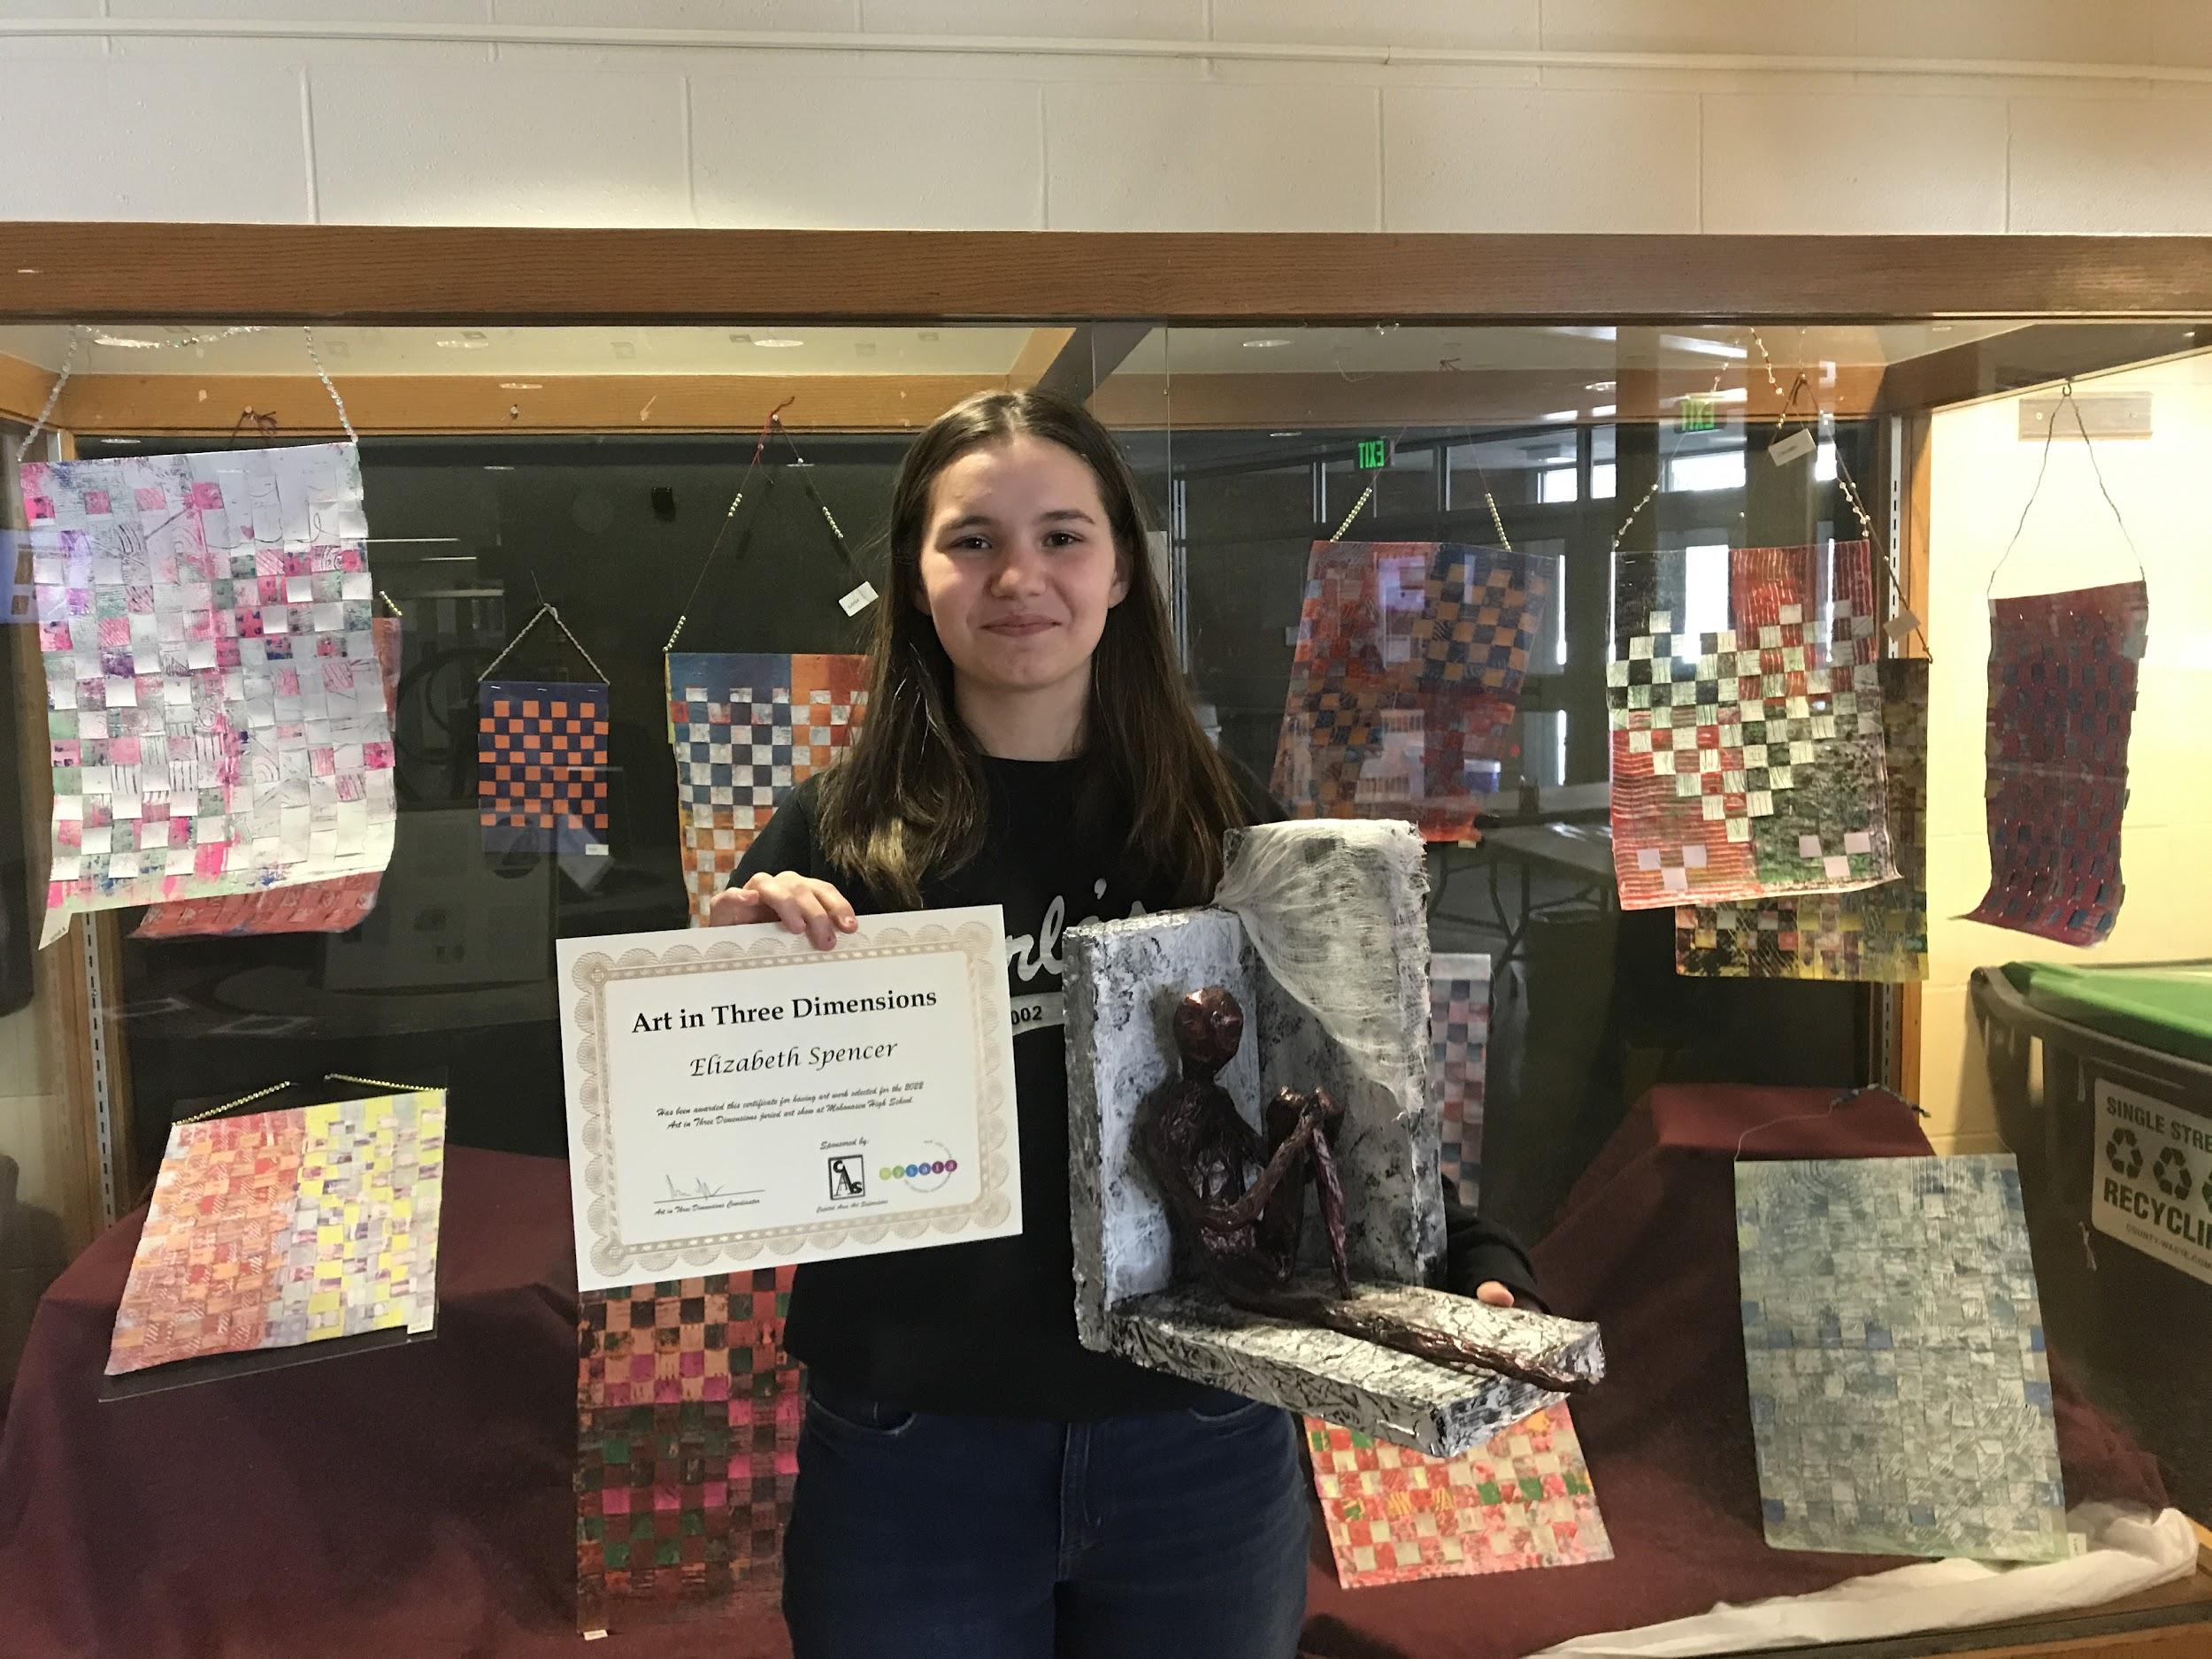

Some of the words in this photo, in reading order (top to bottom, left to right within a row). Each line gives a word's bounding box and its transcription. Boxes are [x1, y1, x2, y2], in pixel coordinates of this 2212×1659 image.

[632, 1011, 672, 1033] Art
[680, 1009, 705, 1029] in
[711, 1003, 784, 1025] Three
[791, 989, 937, 1018] Dimensions
[689, 1046, 802, 1077] Elizabeth
[809, 1042, 898, 1071] Spencer
[657, 1108, 673, 1118] Has
[675, 1106, 691, 1116] been
[693, 1103, 725, 1113] awarded
[726, 1101, 741, 1110] this
[742, 1099, 778, 1110] certificate
[780, 1096, 790, 1107] for
[792, 1094, 816, 1103] having
[832, 1089, 849, 1099] work
[850, 1087, 877, 1097] selected
[879, 1086, 889, 1096] for
[891, 1083, 902, 1093] the
[904, 1081, 925, 1091] 2022
[666, 1120, 682, 1130] Art
[693, 1117, 714, 1127] Three
[715, 1114, 757, 1125] Dimensions
[759, 1110, 781, 1122] juried
[797, 1106, 814, 1117] show
[866, 1098, 886, 1109] High
[2107, 1096, 2166, 1134] SINGLE
[819, 1140, 857, 1151] Sponsored
